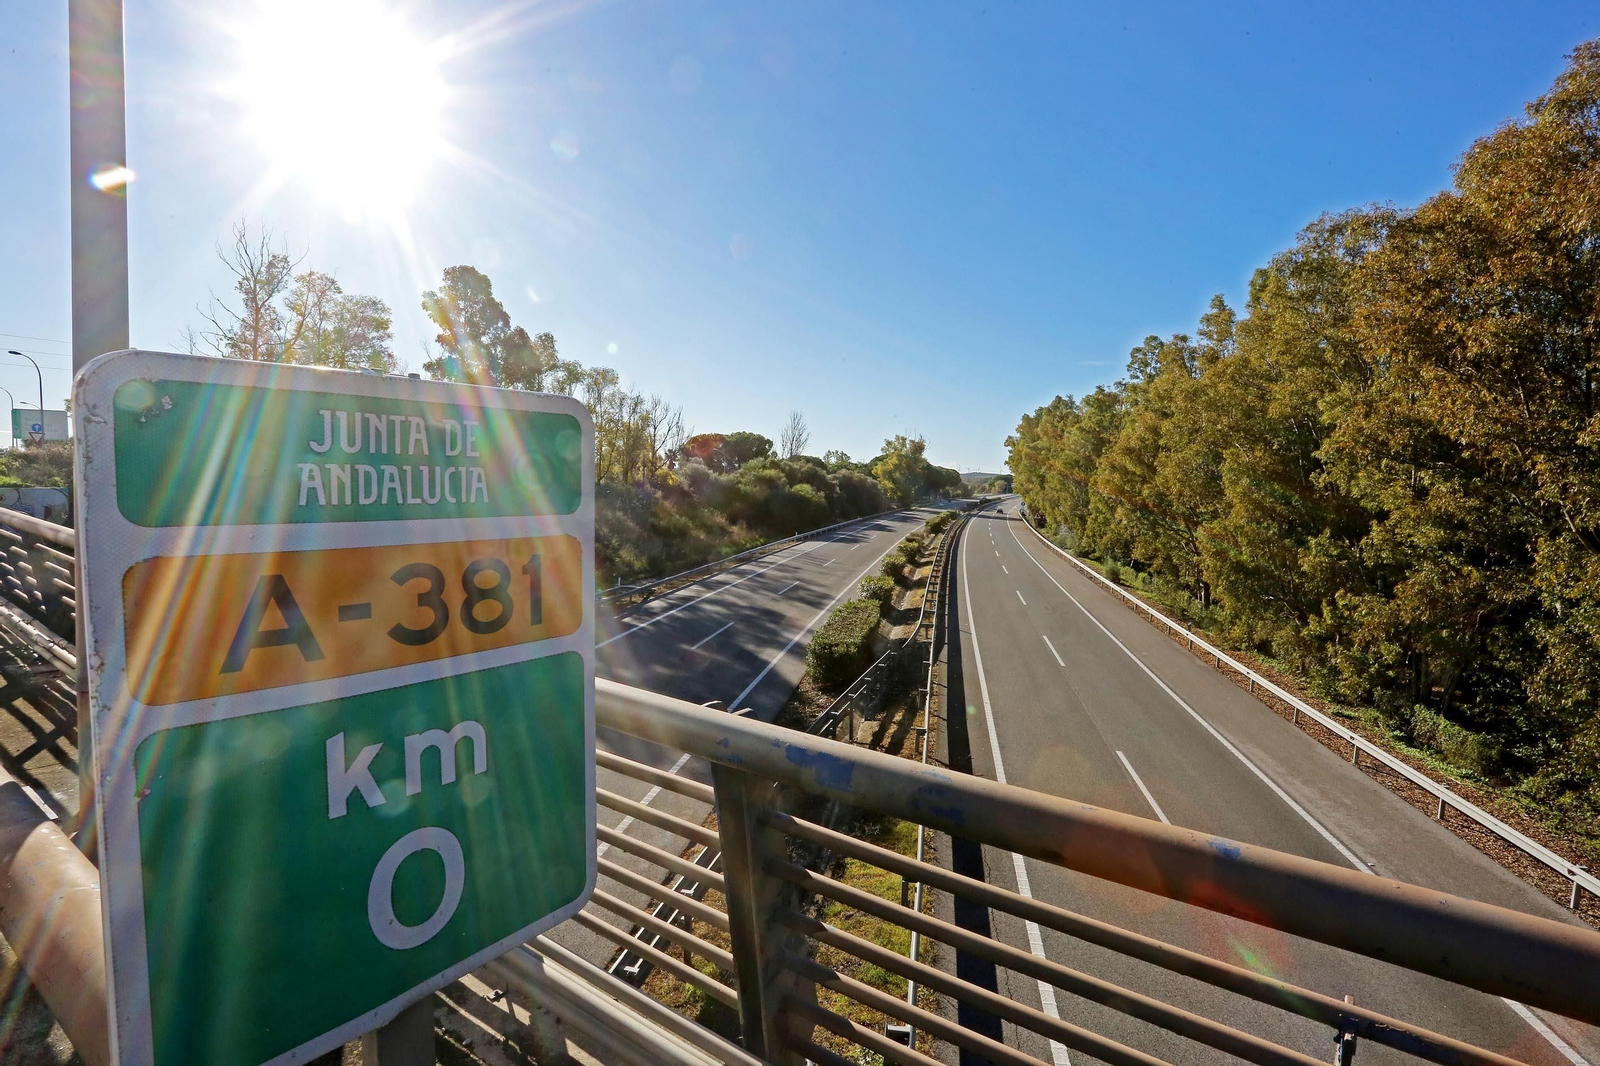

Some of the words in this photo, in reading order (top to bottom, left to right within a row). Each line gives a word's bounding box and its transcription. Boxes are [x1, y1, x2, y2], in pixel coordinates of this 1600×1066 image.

[309, 409, 430, 456] JUNTA
[442, 418, 480, 457] DE
[297, 463, 489, 506] ANDALUCIA
[219, 553, 543, 674] A-381
[325, 719, 488, 820] km
[367, 826, 465, 950] 0
